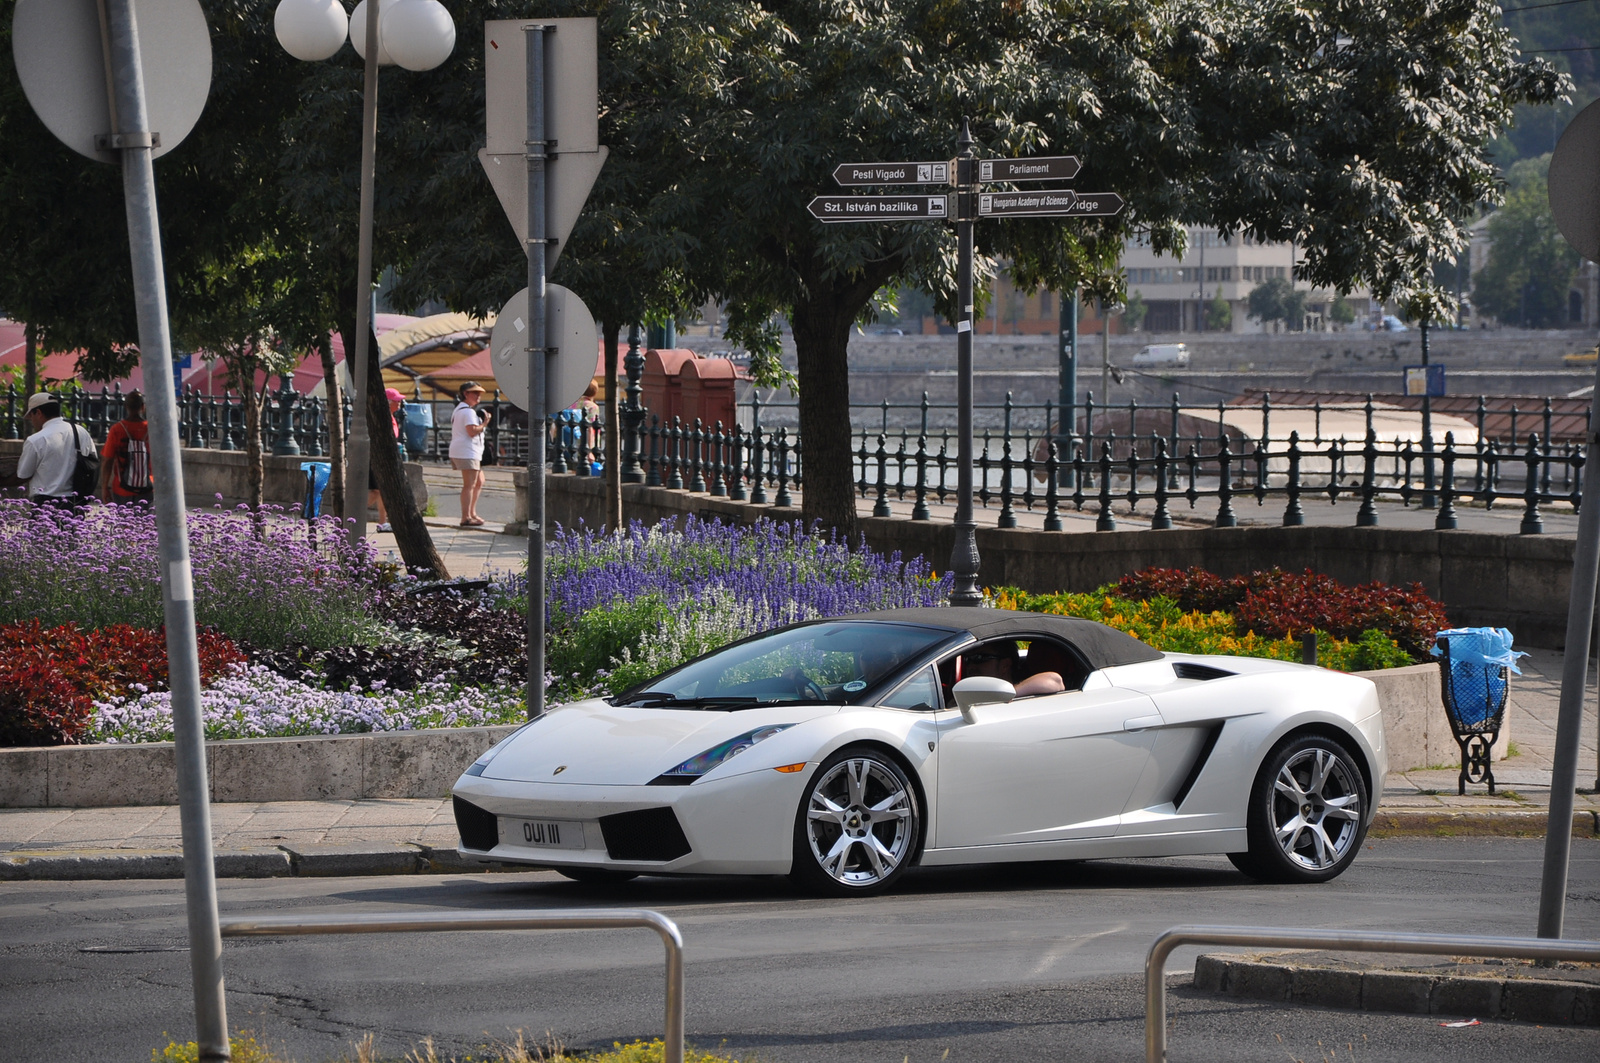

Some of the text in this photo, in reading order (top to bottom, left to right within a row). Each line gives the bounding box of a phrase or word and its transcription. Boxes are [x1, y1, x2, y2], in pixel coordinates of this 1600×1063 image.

[1009, 163, 1049, 174] Parliament
[852, 169, 905, 181] Pesti Vigadó
[824, 202, 918, 212] Szt. István bazilika
[993, 195, 1068, 209] Hungarian Academy of Sciences
[1073, 199, 1099, 211] idge
